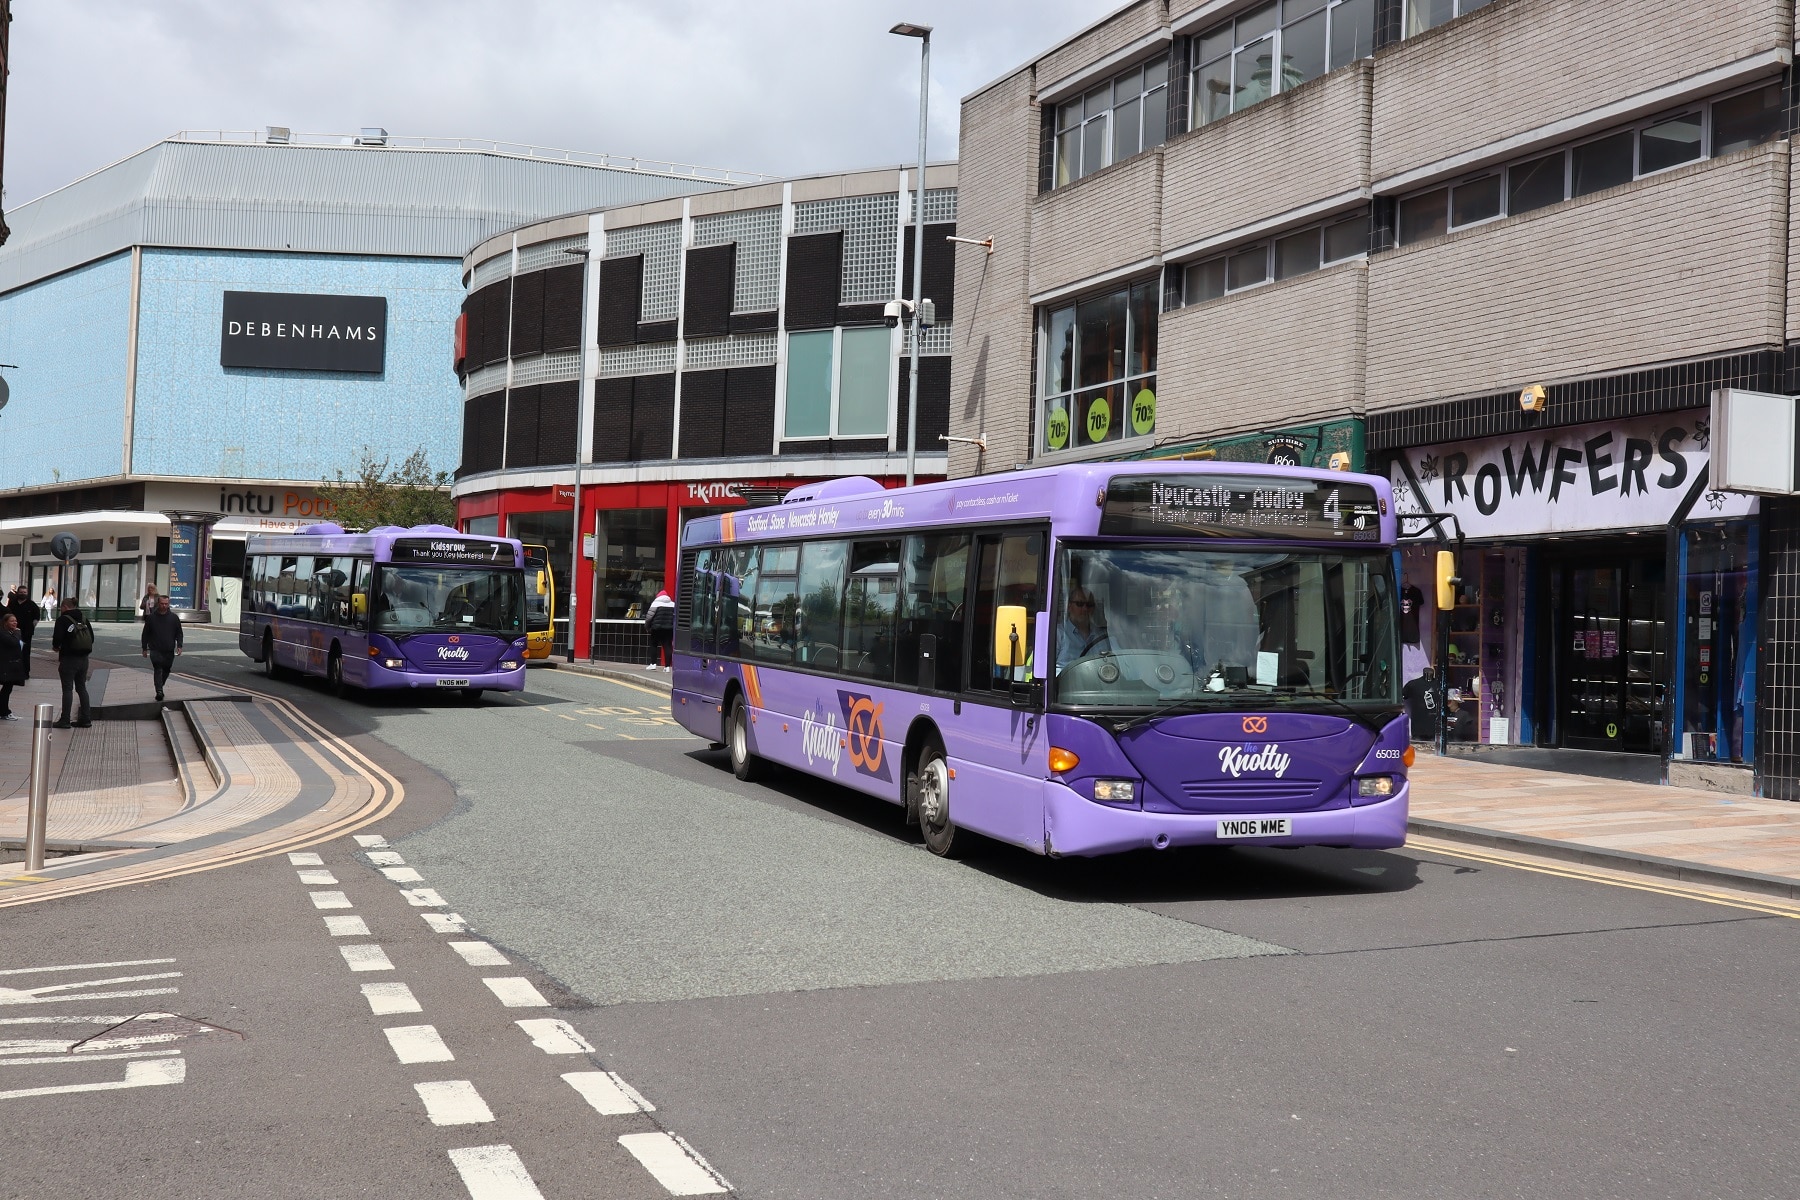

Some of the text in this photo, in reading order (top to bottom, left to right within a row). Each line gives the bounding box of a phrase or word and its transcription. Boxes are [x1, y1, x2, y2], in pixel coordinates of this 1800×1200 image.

[228, 321, 377, 341] DEBENHAMS
[1090, 413, 1107, 431] 70%
[1135, 404, 1153, 423] 70%
[1050, 422, 1066, 439] 70%
[1267, 438, 1304, 448] SUIT HIRE
[1443, 426, 1688, 516] ROWFERS
[219, 486, 274, 514] intu
[1152, 482, 1232, 507] Newcastle
[1252, 486, 1304, 509] Audley
[882, 498, 893, 519] 30
[1149, 506, 1309, 527] Thank you Key Workers!
[1323, 489, 1342, 529] 4
[260, 518, 287, 530] Have
[288, 520, 295, 530] a
[747, 514, 770, 533] Stafford
[770, 513, 786, 531] Stone
[787, 510, 817, 529] Newcastle
[817, 506, 840, 528] Hanley
[412, 549, 484, 560] Thank you Key Workers!
[430, 541, 466, 552] Kidsgrove
[490, 543, 499, 561] 7
[437, 646, 470, 661] Knotty
[801, 709, 842, 777] Knotty
[1243, 742, 1258, 753] the
[1218, 743, 1291, 778] Knotty
[1375, 749, 1400, 759] 65033
[1222, 819, 1286, 836] YN06 WME
